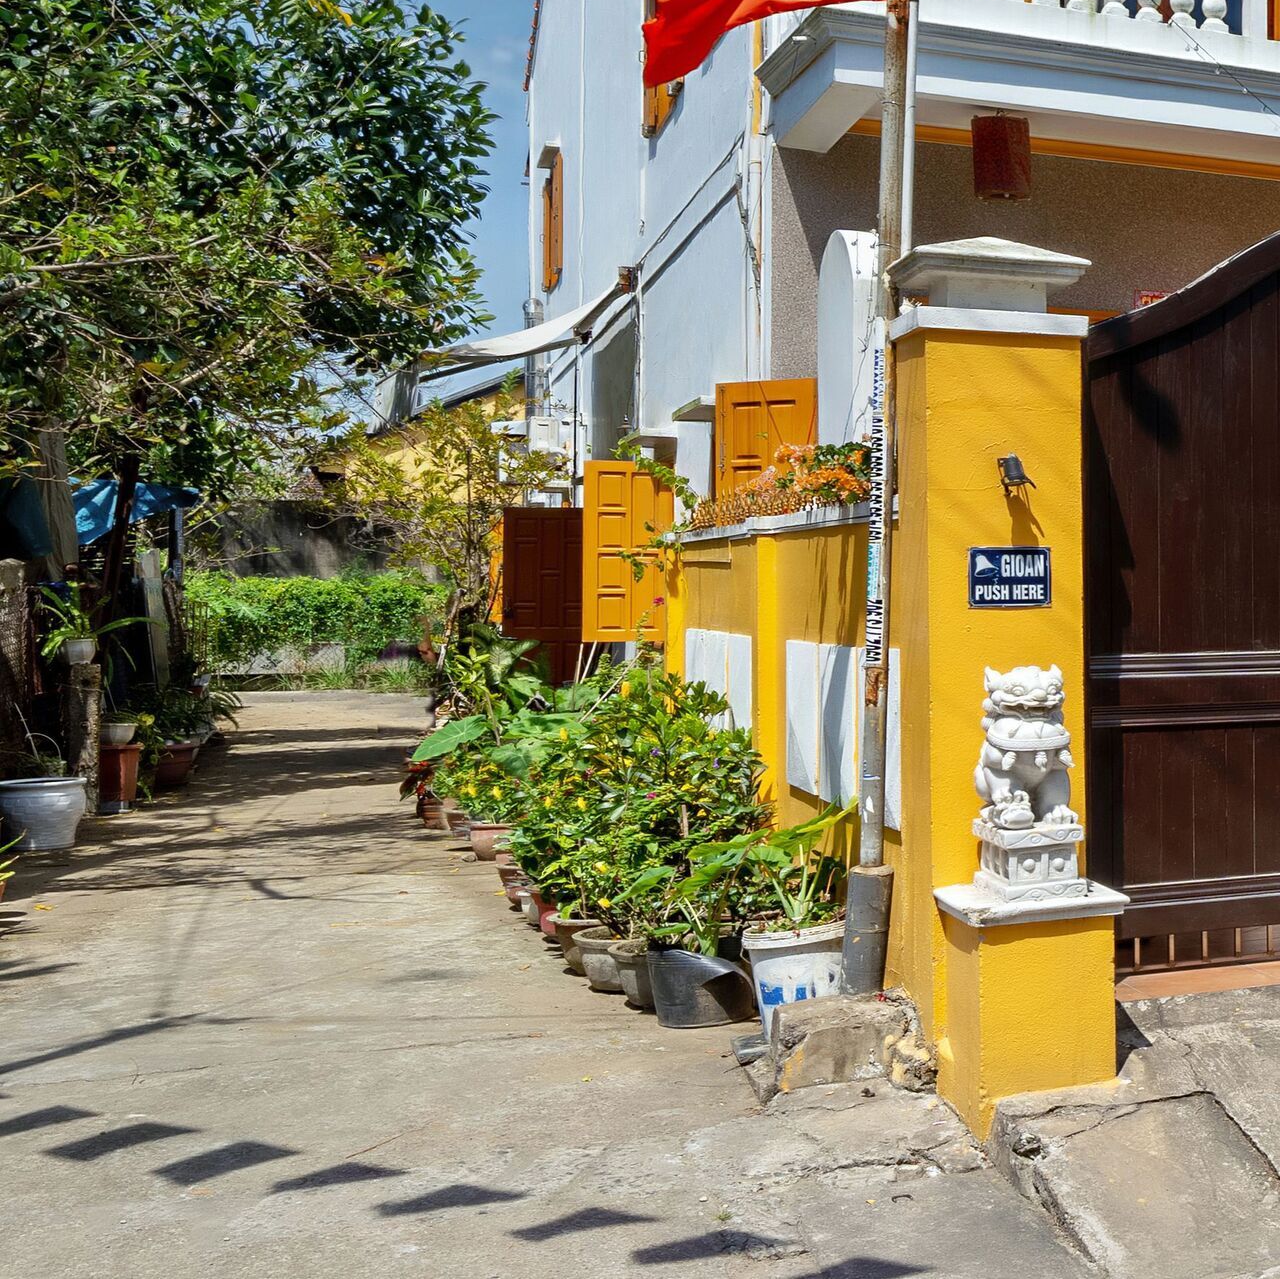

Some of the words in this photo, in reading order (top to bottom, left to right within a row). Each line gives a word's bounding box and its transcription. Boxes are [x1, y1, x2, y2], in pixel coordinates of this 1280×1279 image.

[1001, 554, 1044, 577] GIOAN
[975, 584, 1009, 600] PUSH
[1012, 584, 1044, 600] HERE
